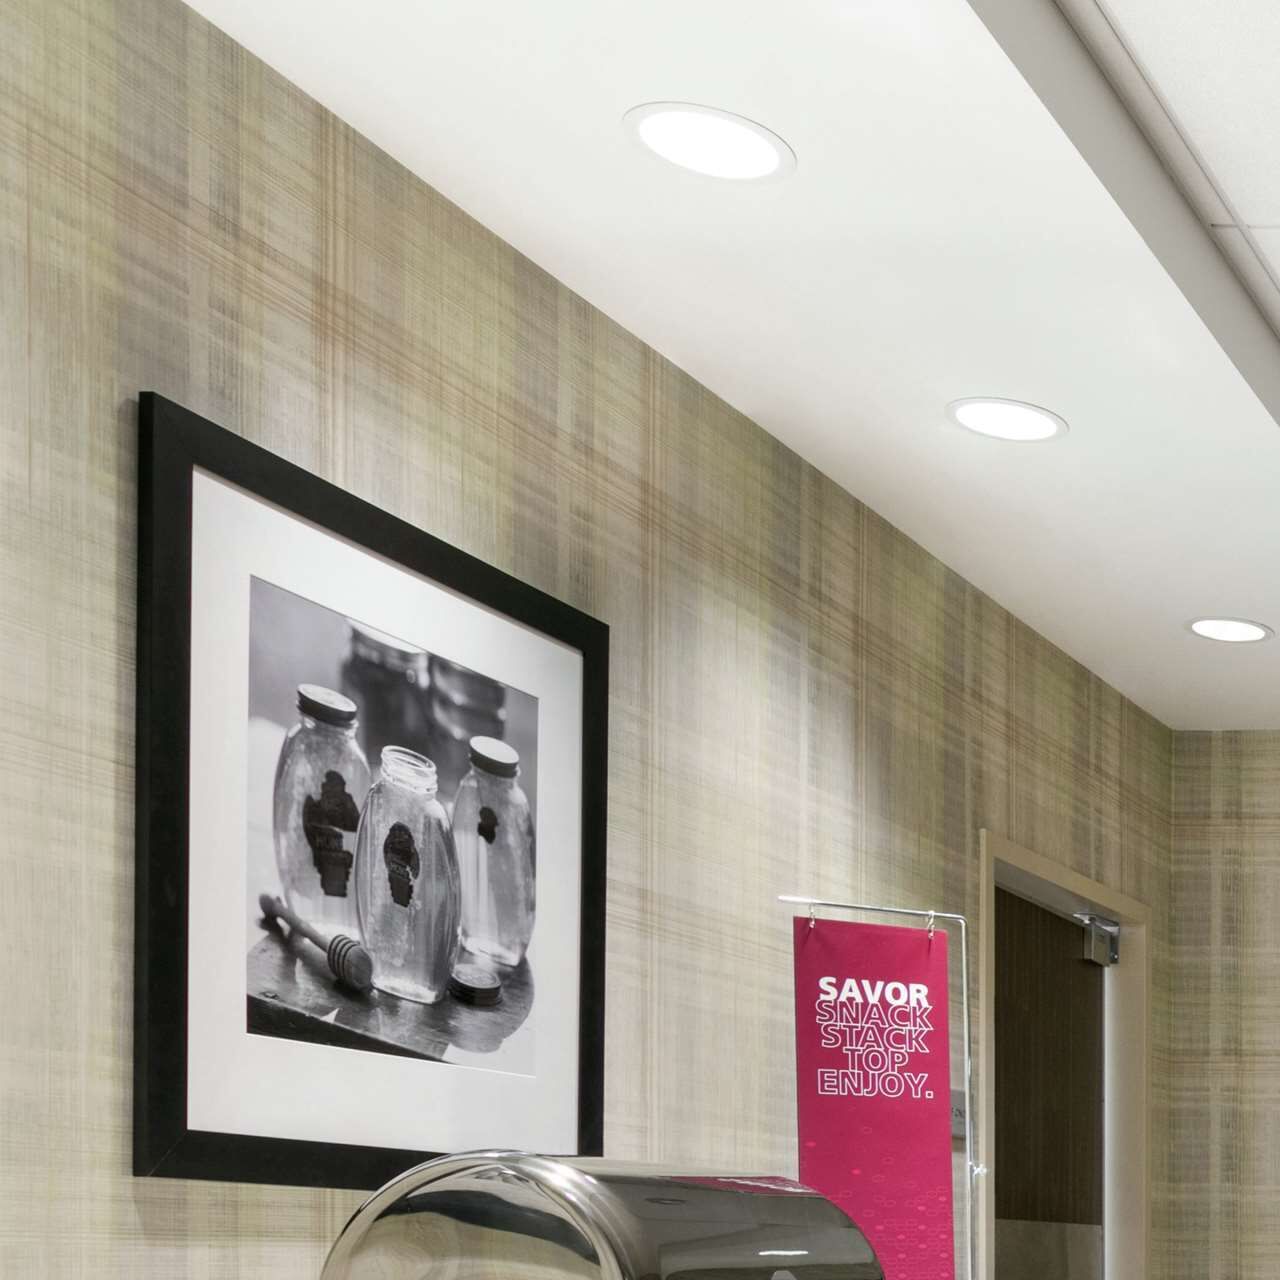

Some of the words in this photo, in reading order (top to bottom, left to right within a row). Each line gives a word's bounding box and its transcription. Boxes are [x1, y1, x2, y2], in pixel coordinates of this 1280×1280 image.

[818, 976, 929, 1007] SAVOR
[815, 999, 933, 1031] SNACK
[820, 1021, 930, 1053] STACK
[842, 1047, 909, 1074] TOP
[817, 1068, 934, 1099] ENJOY.
